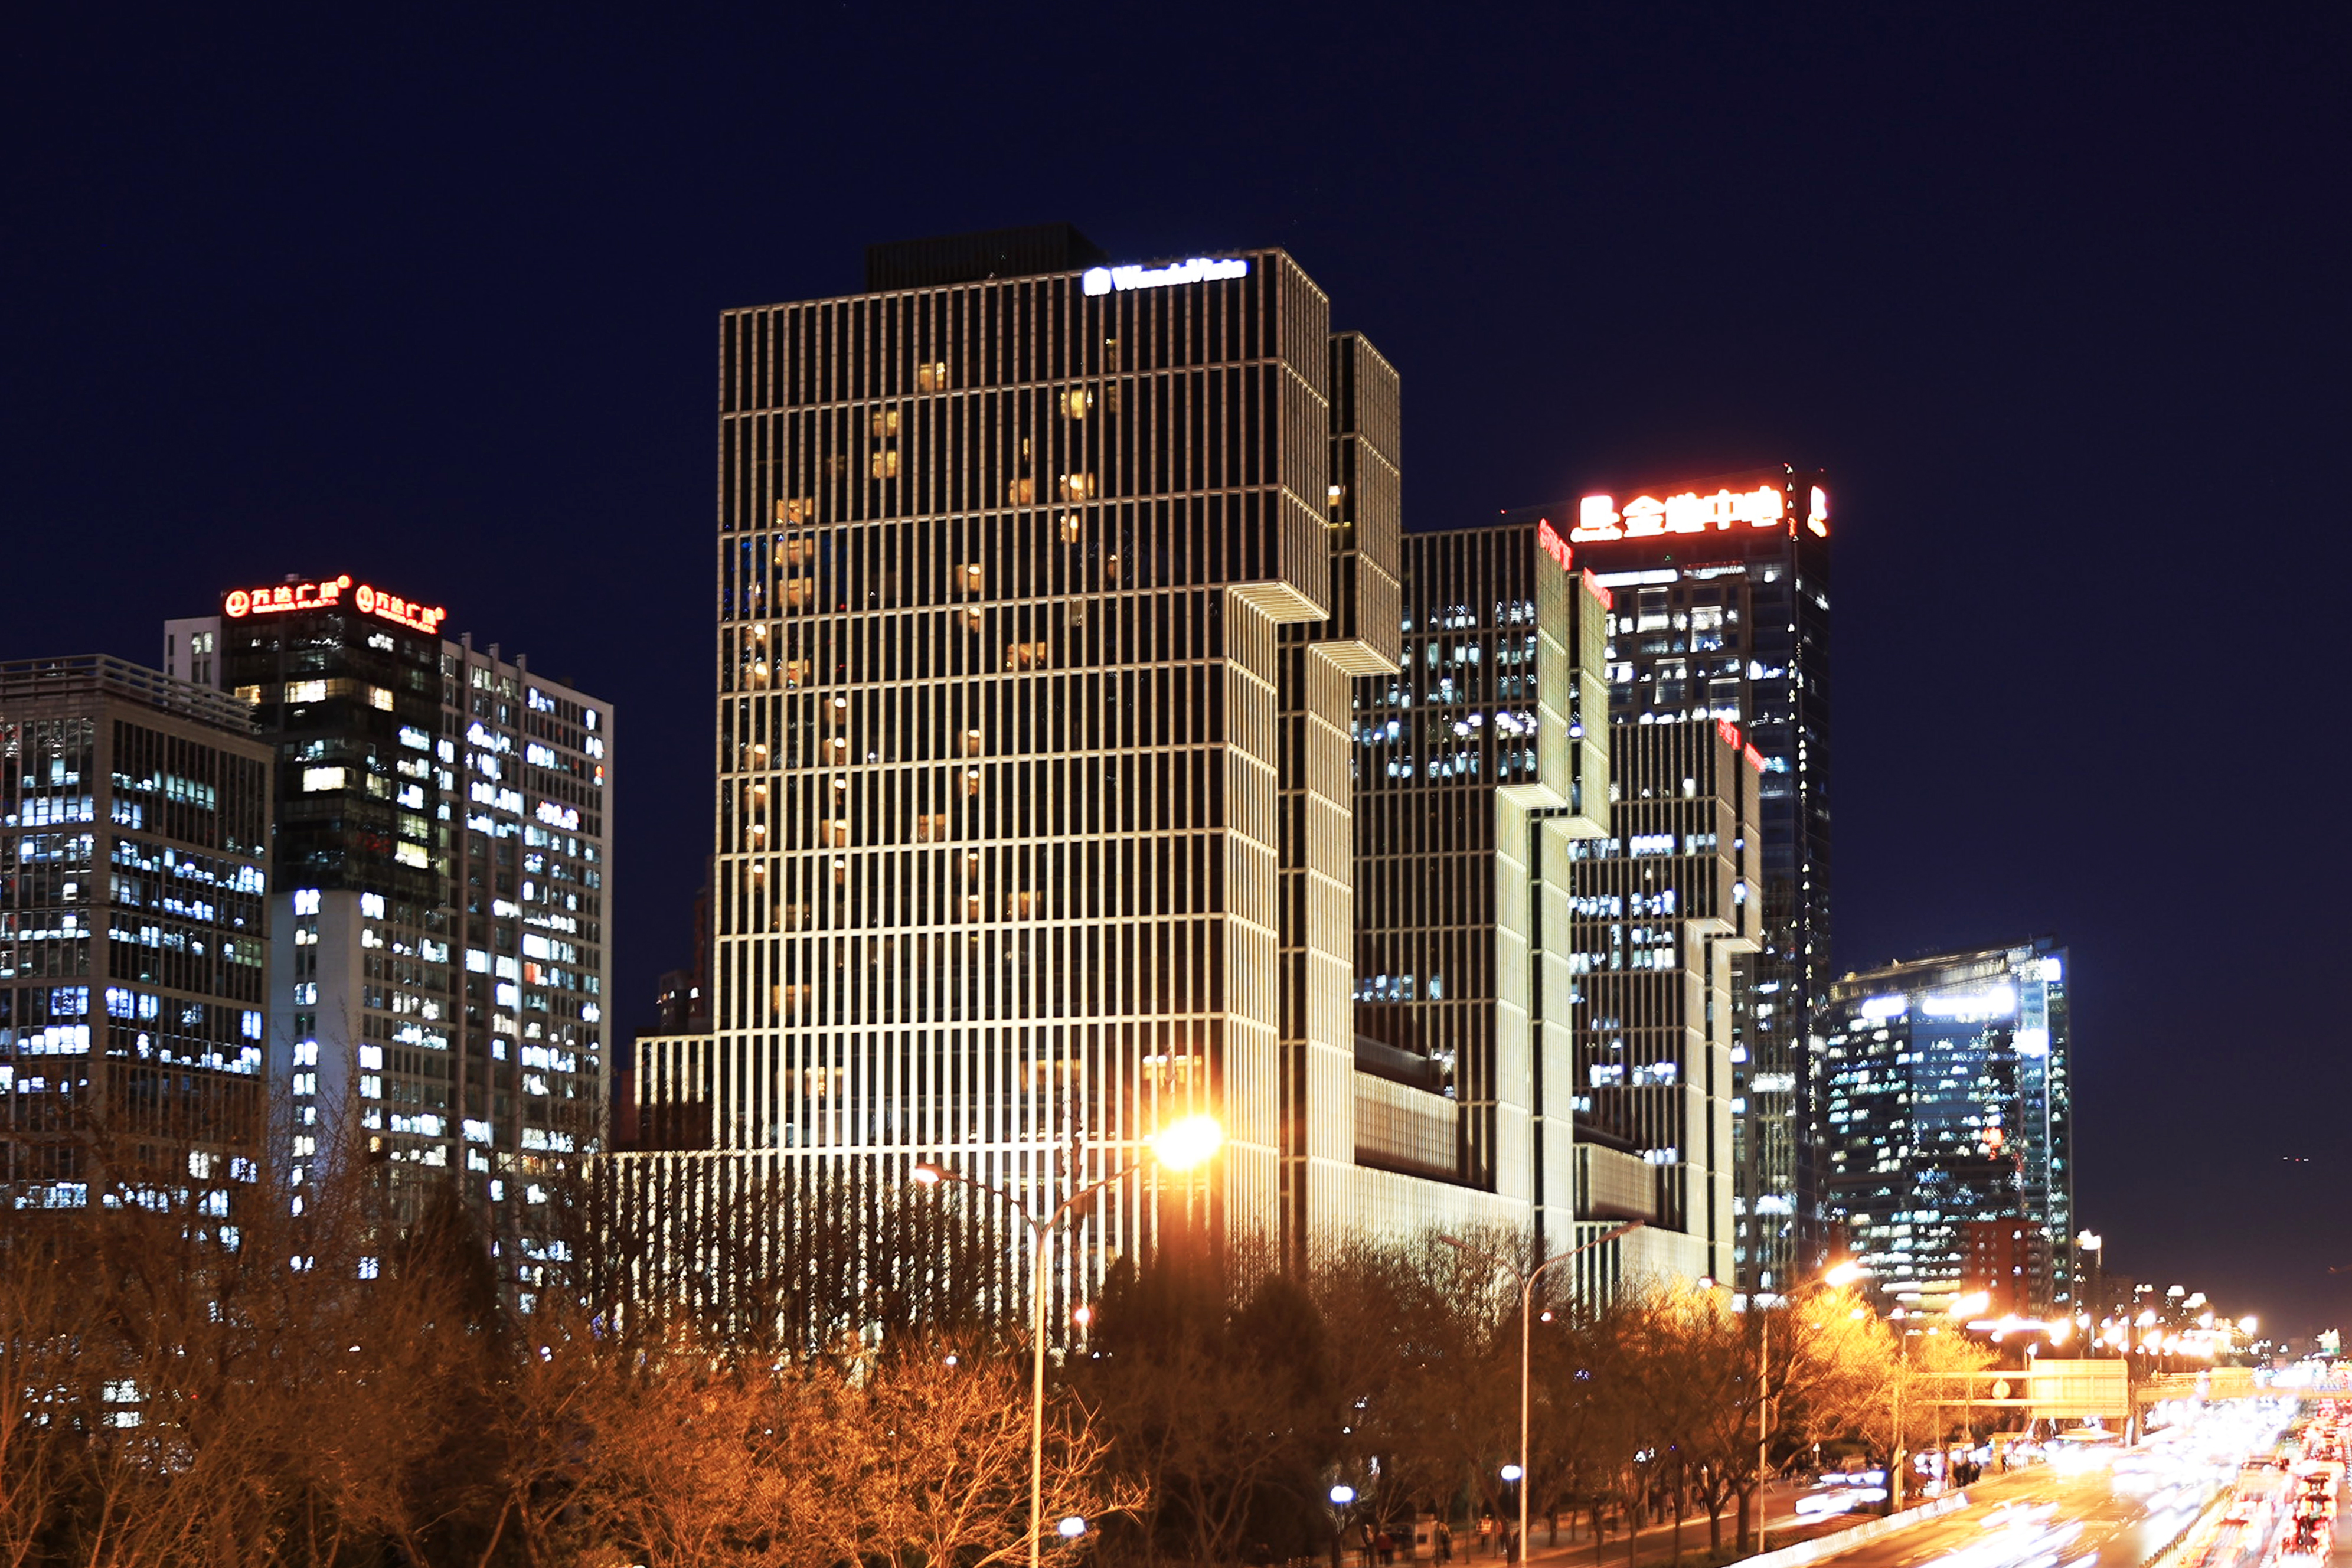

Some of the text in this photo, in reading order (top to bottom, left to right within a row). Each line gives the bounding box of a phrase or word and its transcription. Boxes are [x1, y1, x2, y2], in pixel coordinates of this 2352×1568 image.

[251, 582, 339, 606] 万达广场
[375, 591, 437, 626] 万达广场
